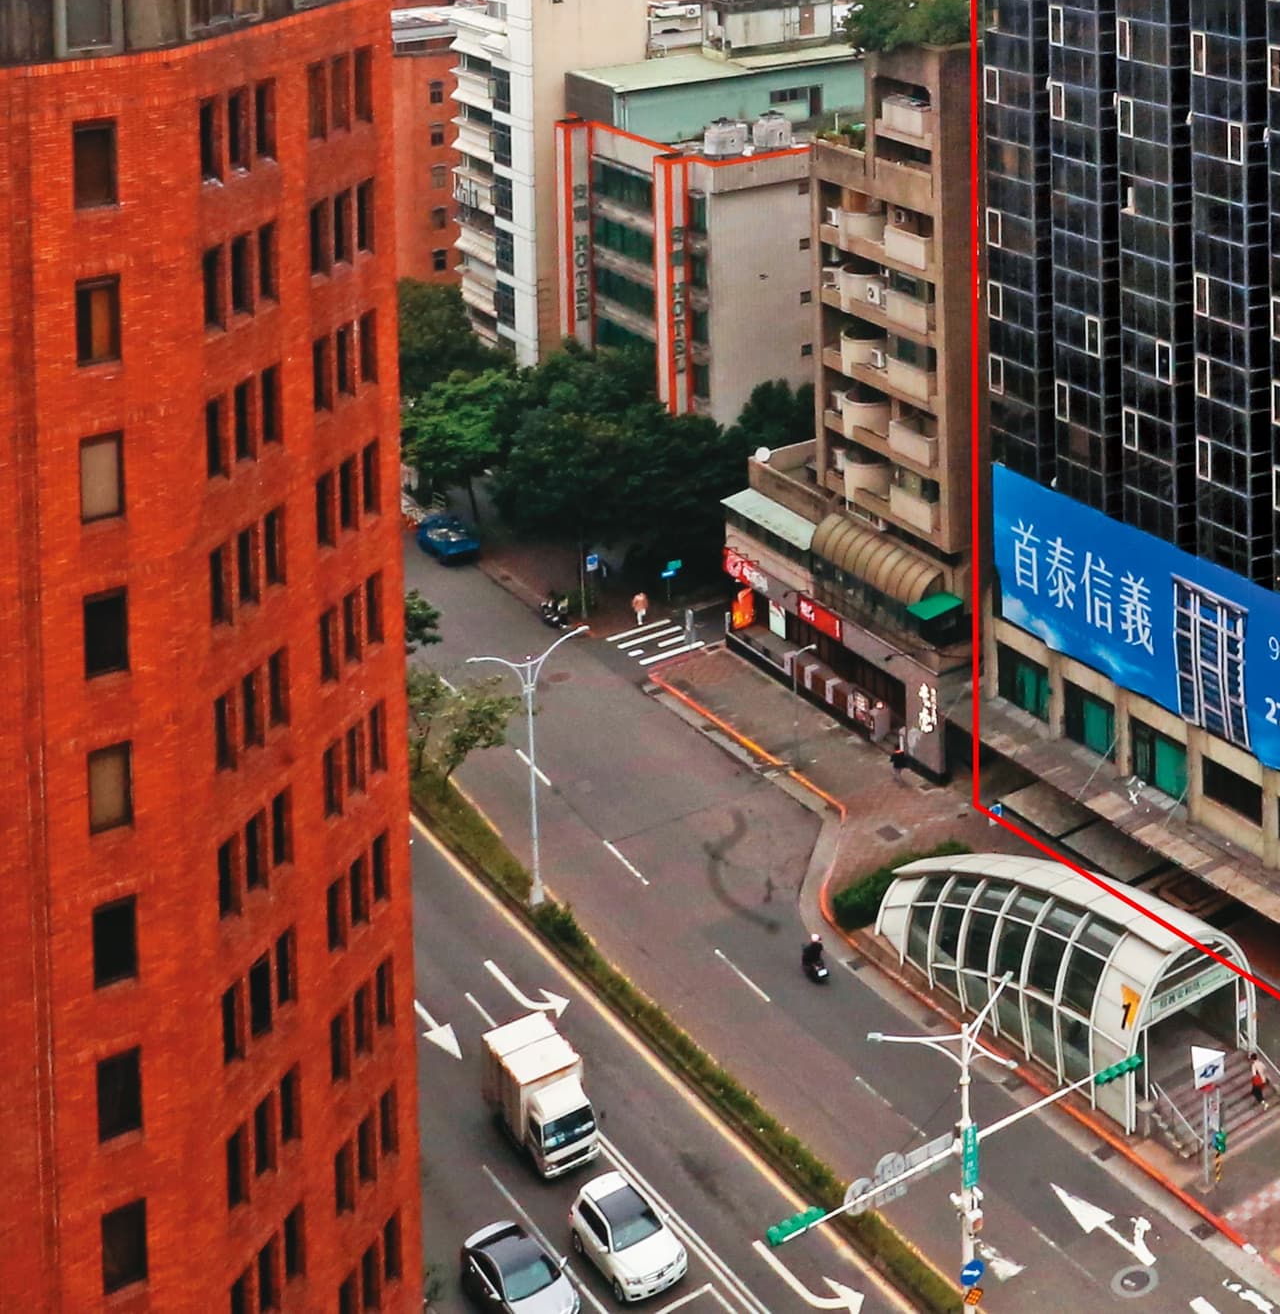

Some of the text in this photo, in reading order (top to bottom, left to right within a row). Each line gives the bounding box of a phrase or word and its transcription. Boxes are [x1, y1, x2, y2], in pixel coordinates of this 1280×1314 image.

[1011, 519, 1154, 657] 首泰信義
[1121, 1002, 1132, 1031] 1
